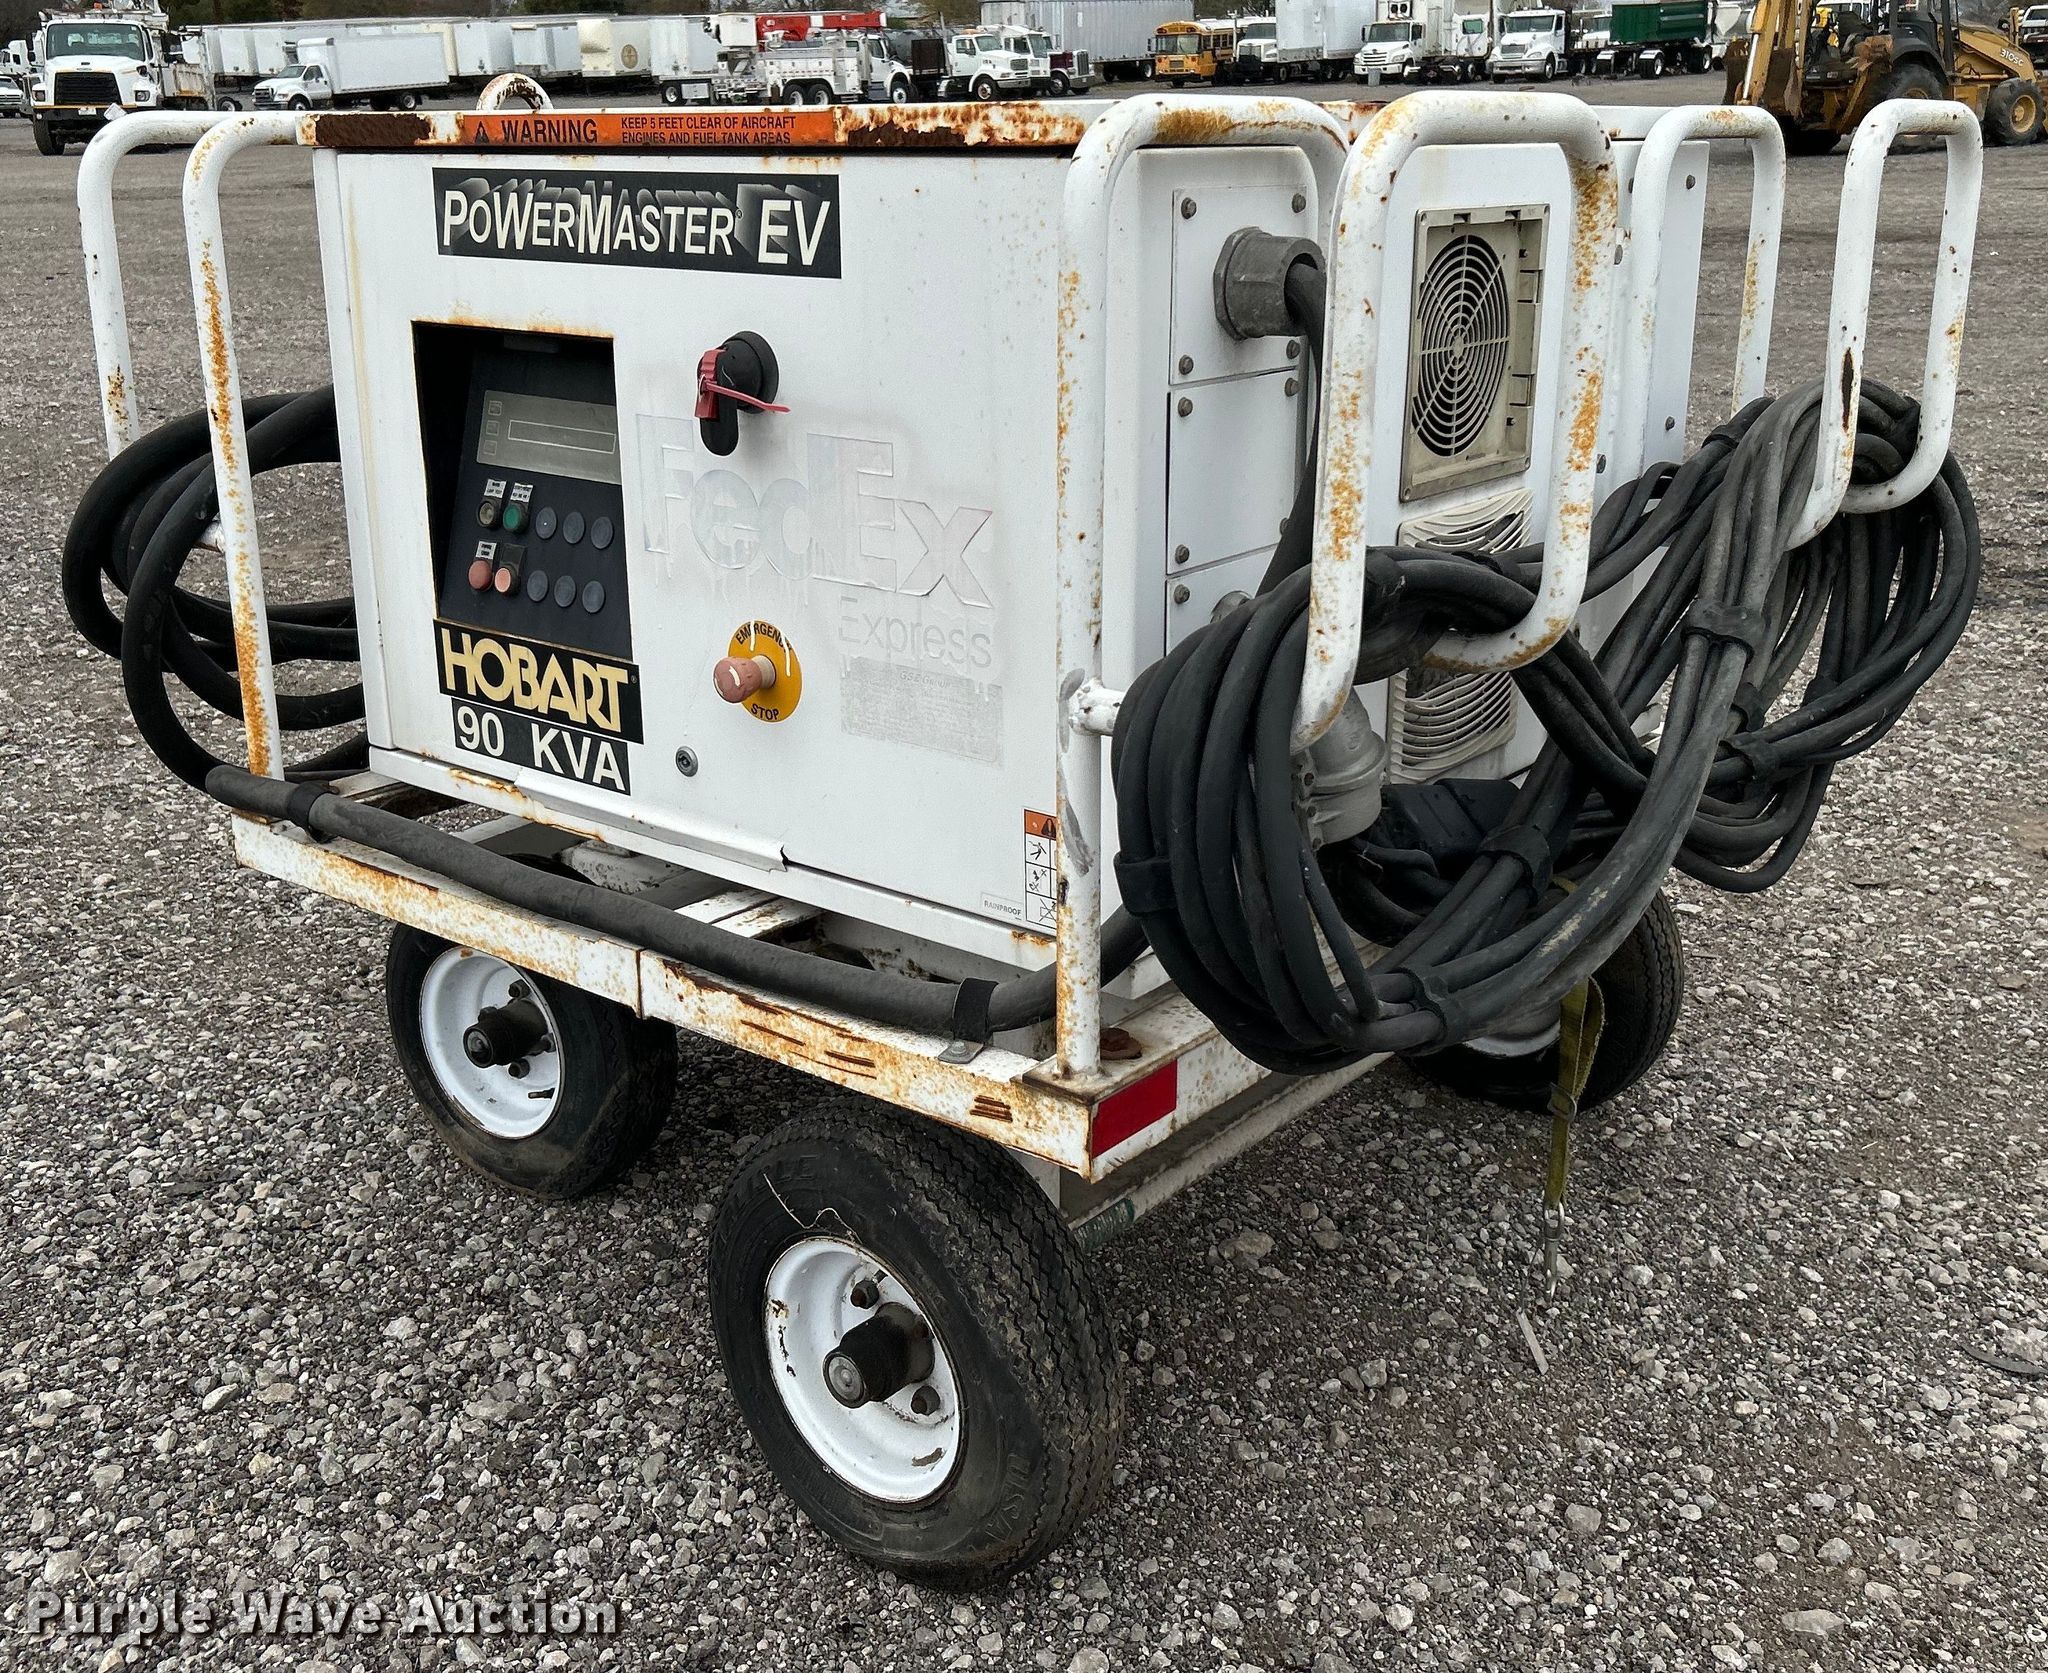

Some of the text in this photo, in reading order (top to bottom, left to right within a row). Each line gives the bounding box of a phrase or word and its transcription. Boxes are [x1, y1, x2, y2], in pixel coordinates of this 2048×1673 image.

[502, 119, 598, 143] WARNING
[621, 116, 796, 129] KEEP 5 FEET CLEAR OF AIRCRAFT
[622, 132, 791, 144] ENGINES AND FUEL TANK AREAS
[758, 198, 831, 266] EV
[636, 413, 993, 609] FedEx
[840, 595, 992, 669] Express
[441, 628, 629, 733] HOBART
[751, 704, 779, 720] STOP
[457, 705, 626, 791] 90 KVA
[984, 900, 1022, 916] RAINPROOF
